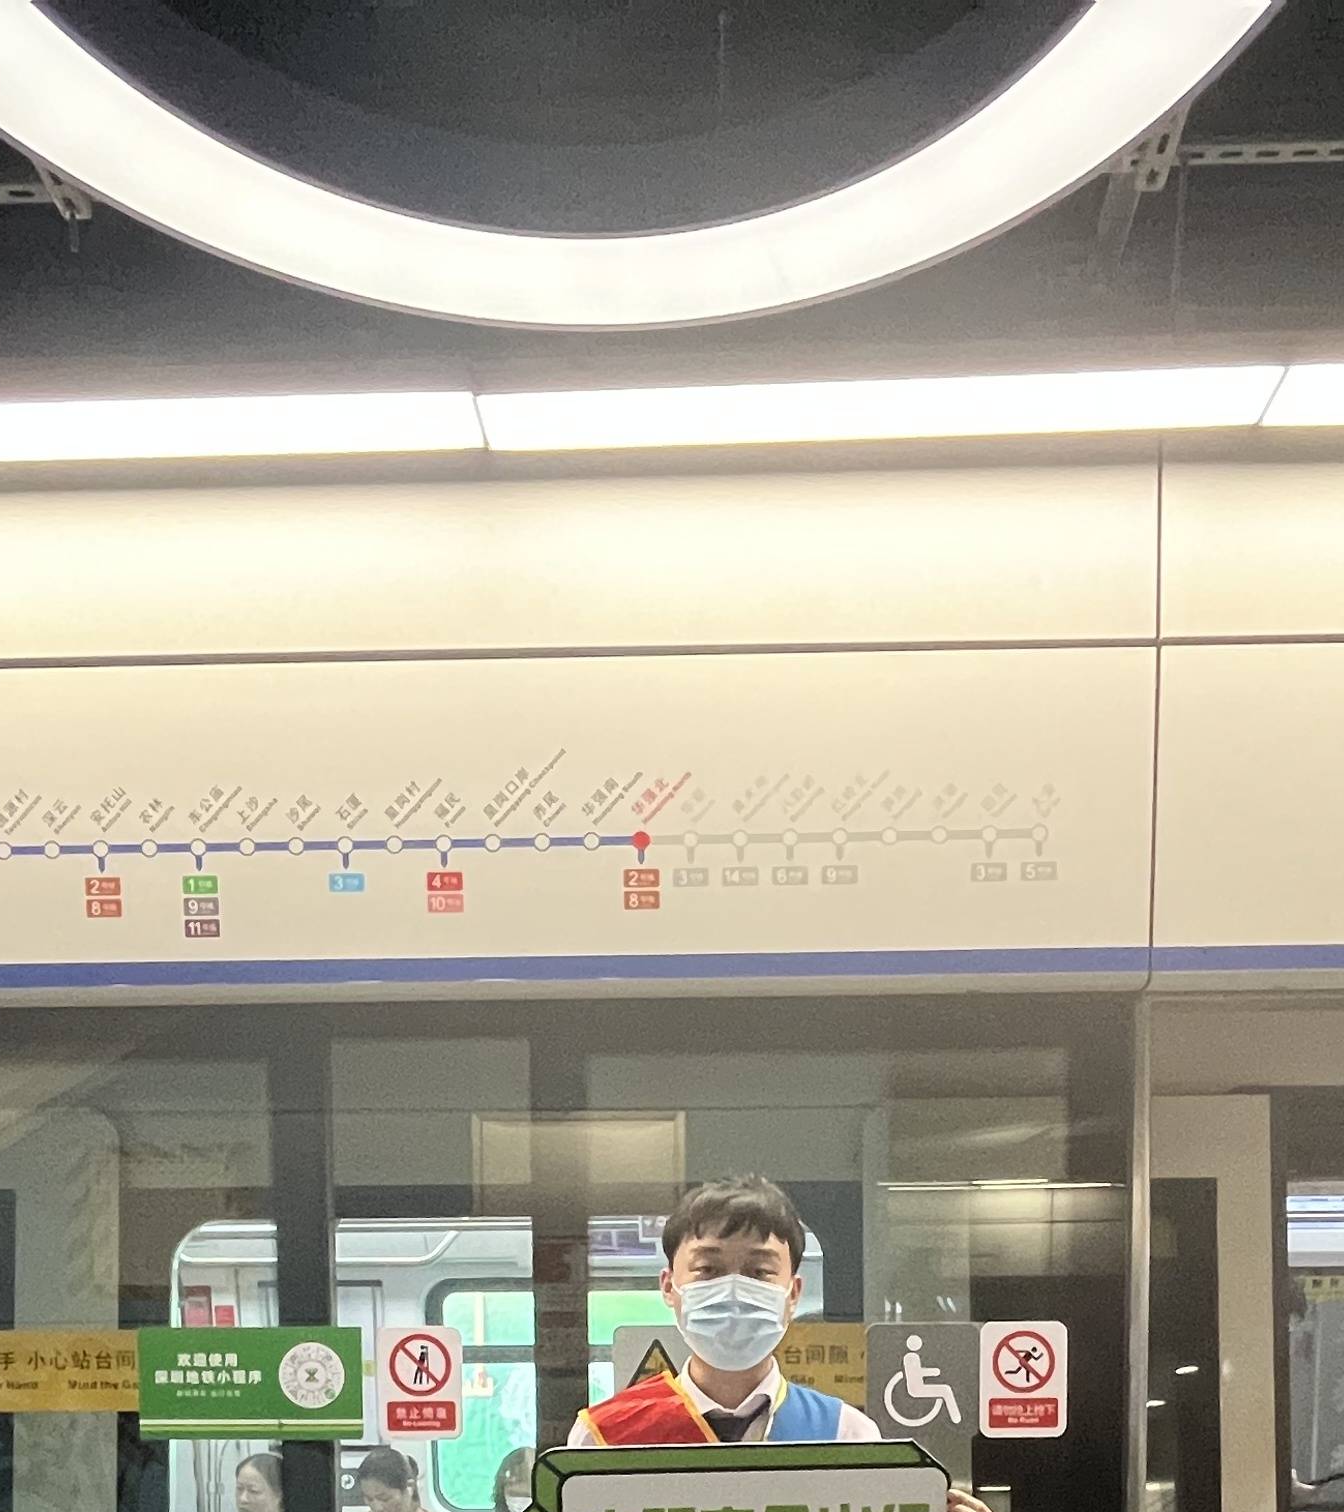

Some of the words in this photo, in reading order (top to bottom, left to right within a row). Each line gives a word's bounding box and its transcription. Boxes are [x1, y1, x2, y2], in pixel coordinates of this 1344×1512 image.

[27, 1350, 136, 1371] 小心站台间
